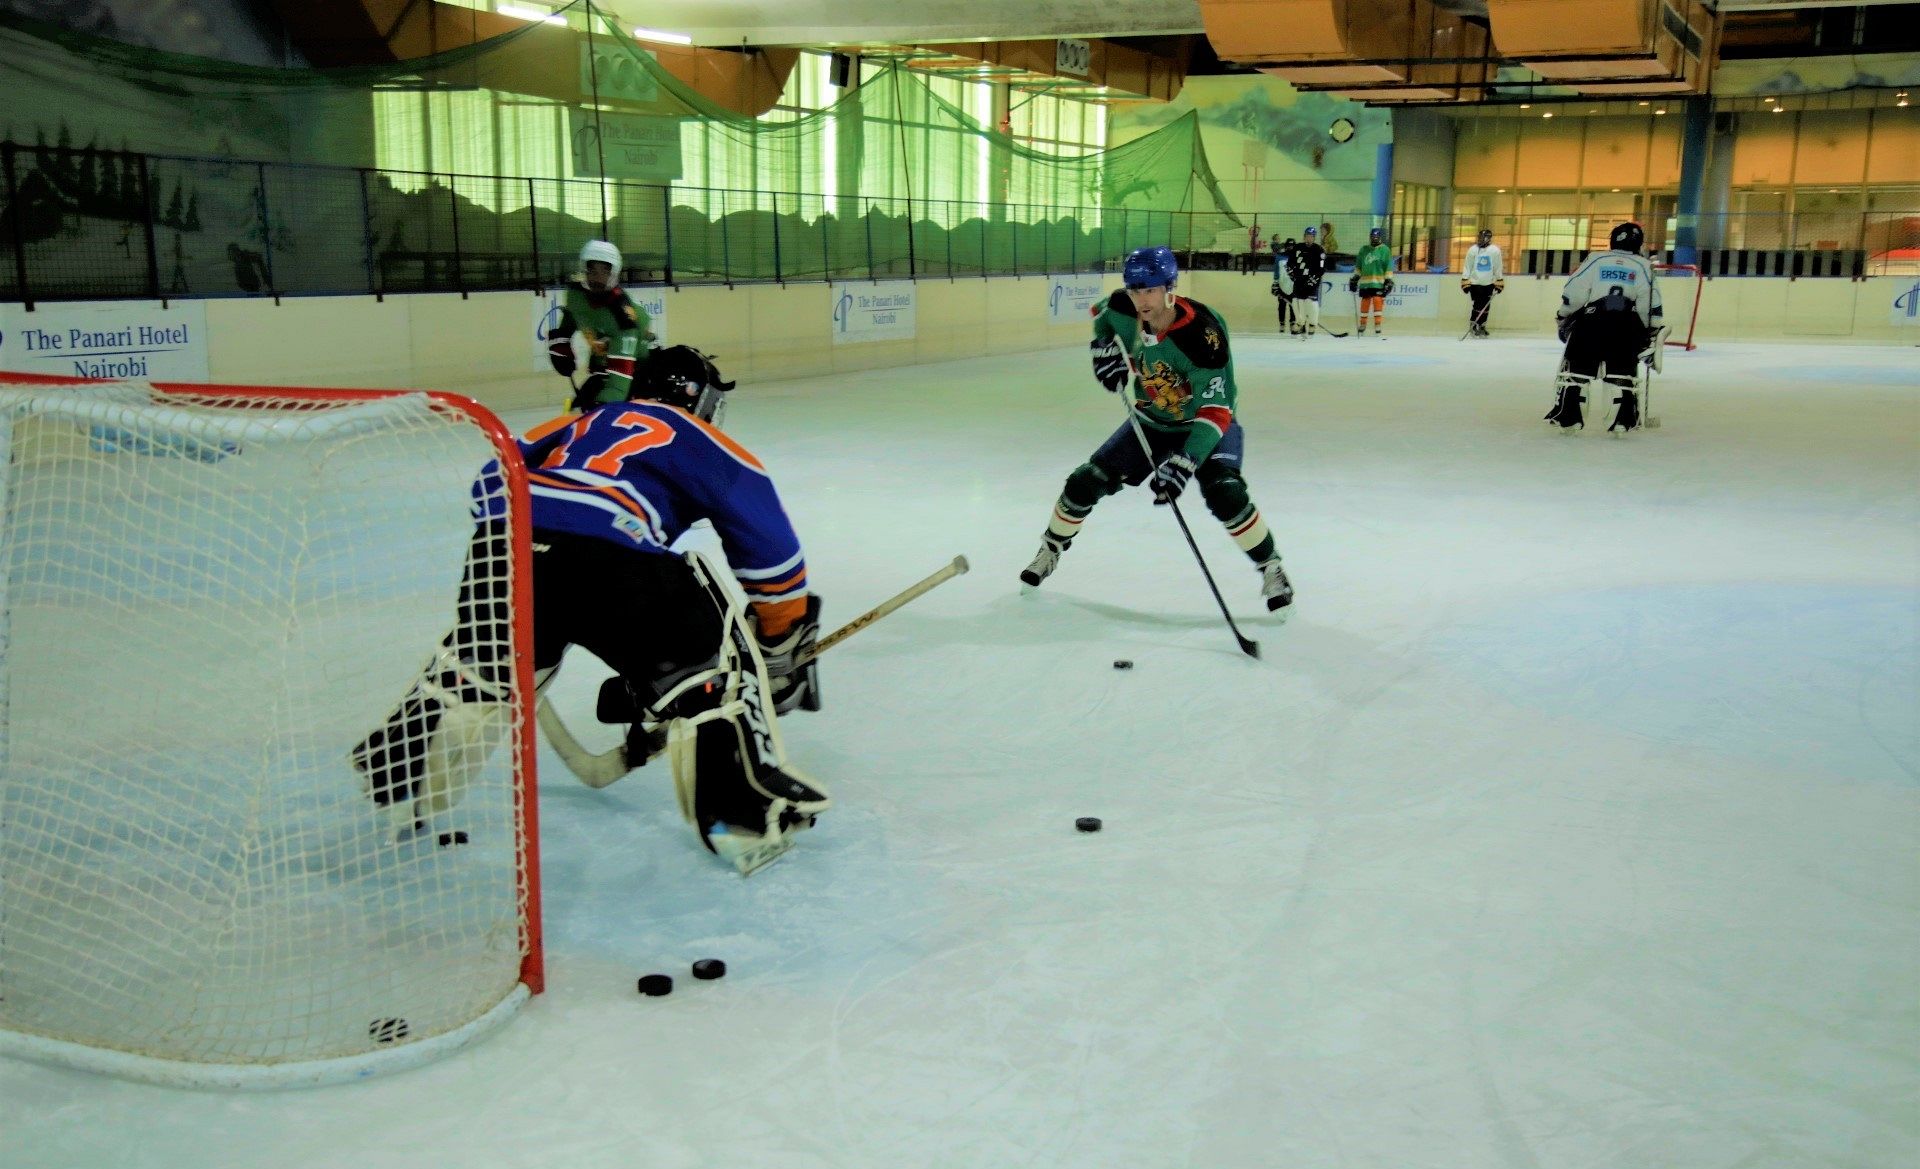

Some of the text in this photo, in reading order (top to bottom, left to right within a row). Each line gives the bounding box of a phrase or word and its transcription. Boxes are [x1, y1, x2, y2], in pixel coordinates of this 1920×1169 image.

[1601, 270, 1628, 281] ERSTE
[1400, 284, 1429, 294] Hotel
[857, 293, 911, 308] The Panari Hotel
[872, 311, 897, 325] Nairobi
[22, 324, 188, 350] The Panari Hotel
[74, 356, 148, 379] Nairobi
[1202, 376, 1226, 399] 34
[538, 408, 677, 477] 17
